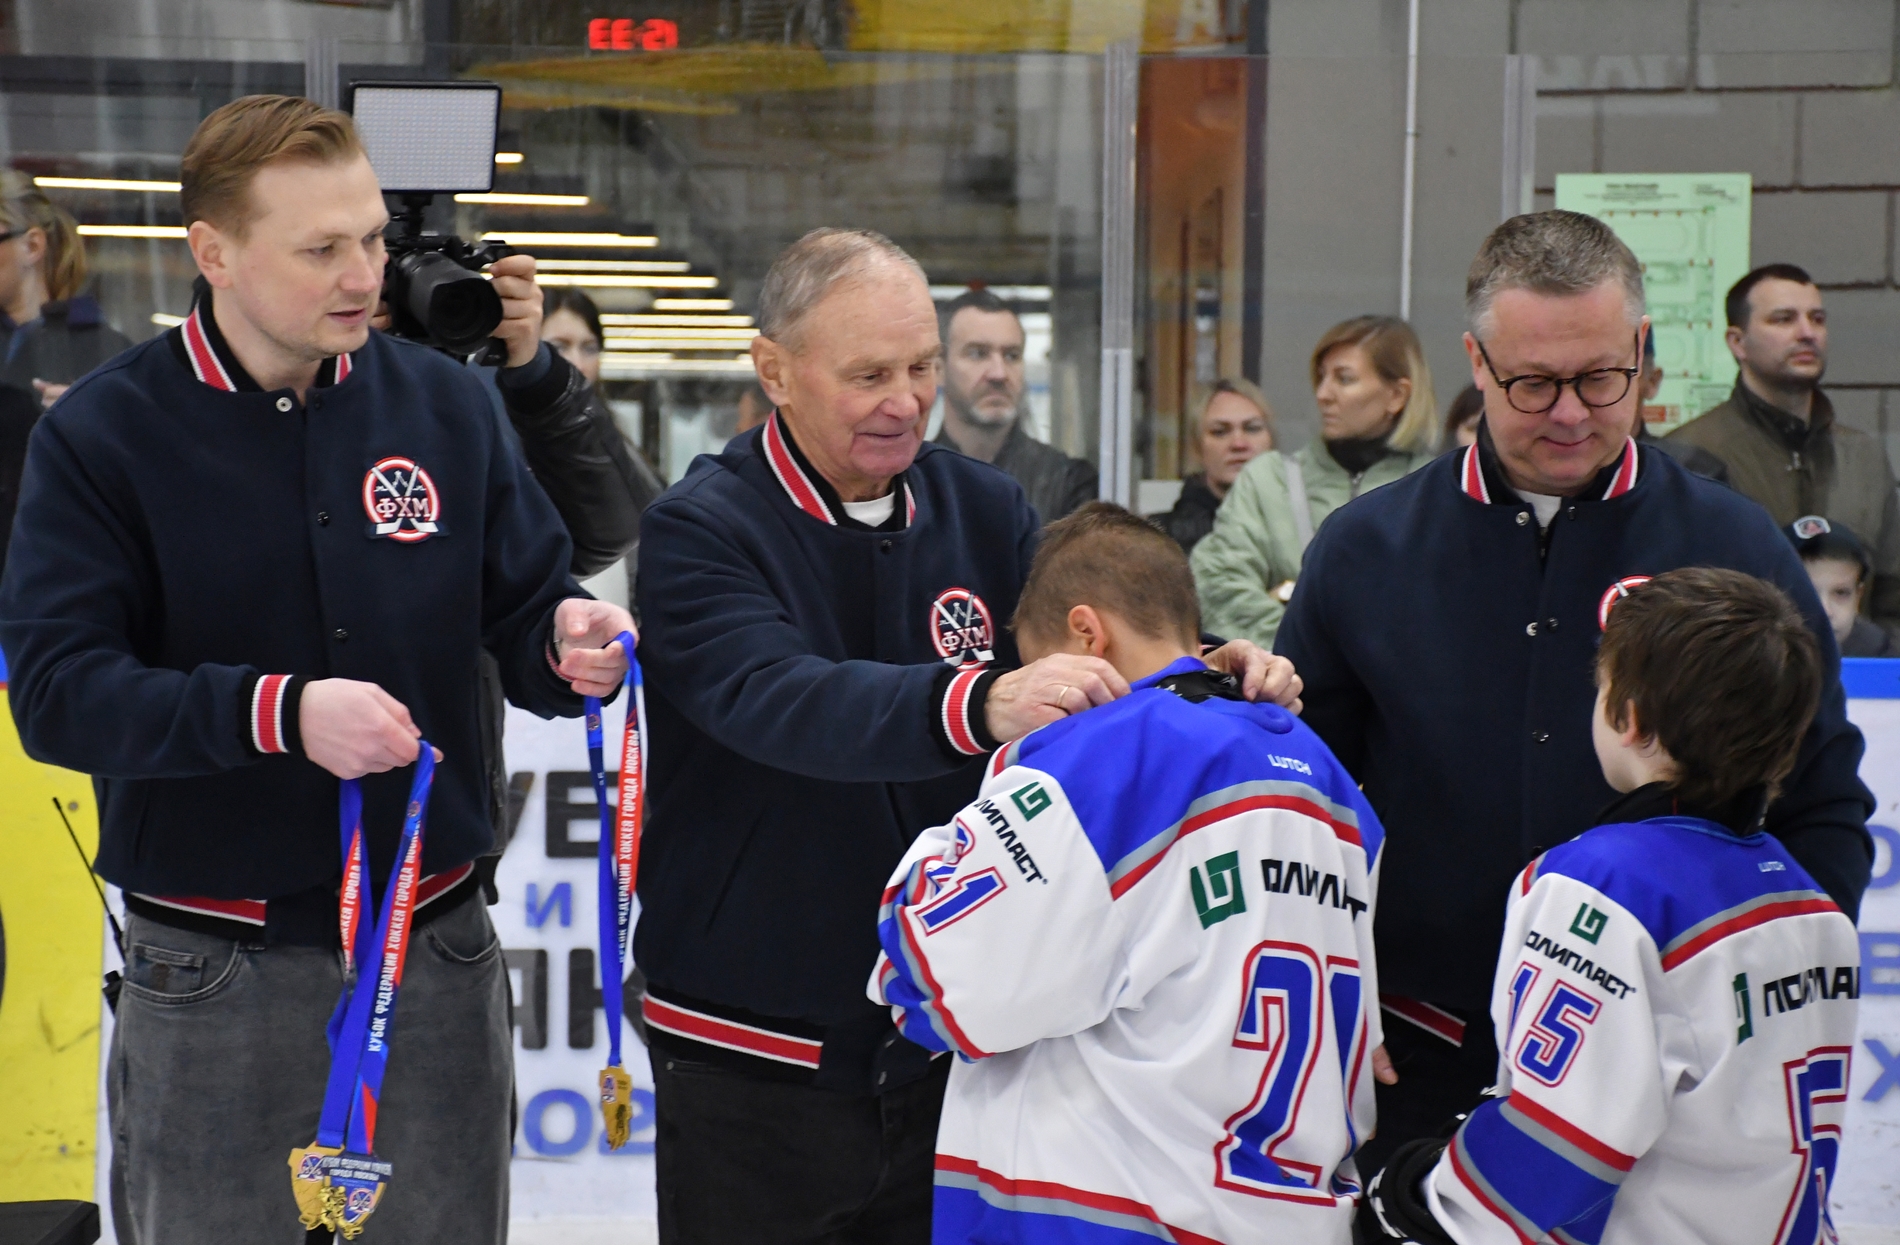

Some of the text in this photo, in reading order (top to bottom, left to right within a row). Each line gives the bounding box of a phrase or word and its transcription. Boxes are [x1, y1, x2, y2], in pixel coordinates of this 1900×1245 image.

[375, 497, 432, 518] ФХМ
[941, 626, 989, 652] ФХМ
[1267, 754, 1312, 776] LUTCH
[621, 778, 638, 817] ГОРОДА
[619, 820, 635, 860] ХОККЕЯ
[394, 867, 415, 907] ГОРОДА
[386, 908, 407, 950] ХОККЕЯ
[375, 952, 398, 1014] ФЕДЕРАЦИИ
[367, 1017, 387, 1052] КУБОК
[1504, 961, 1603, 1088] 15
